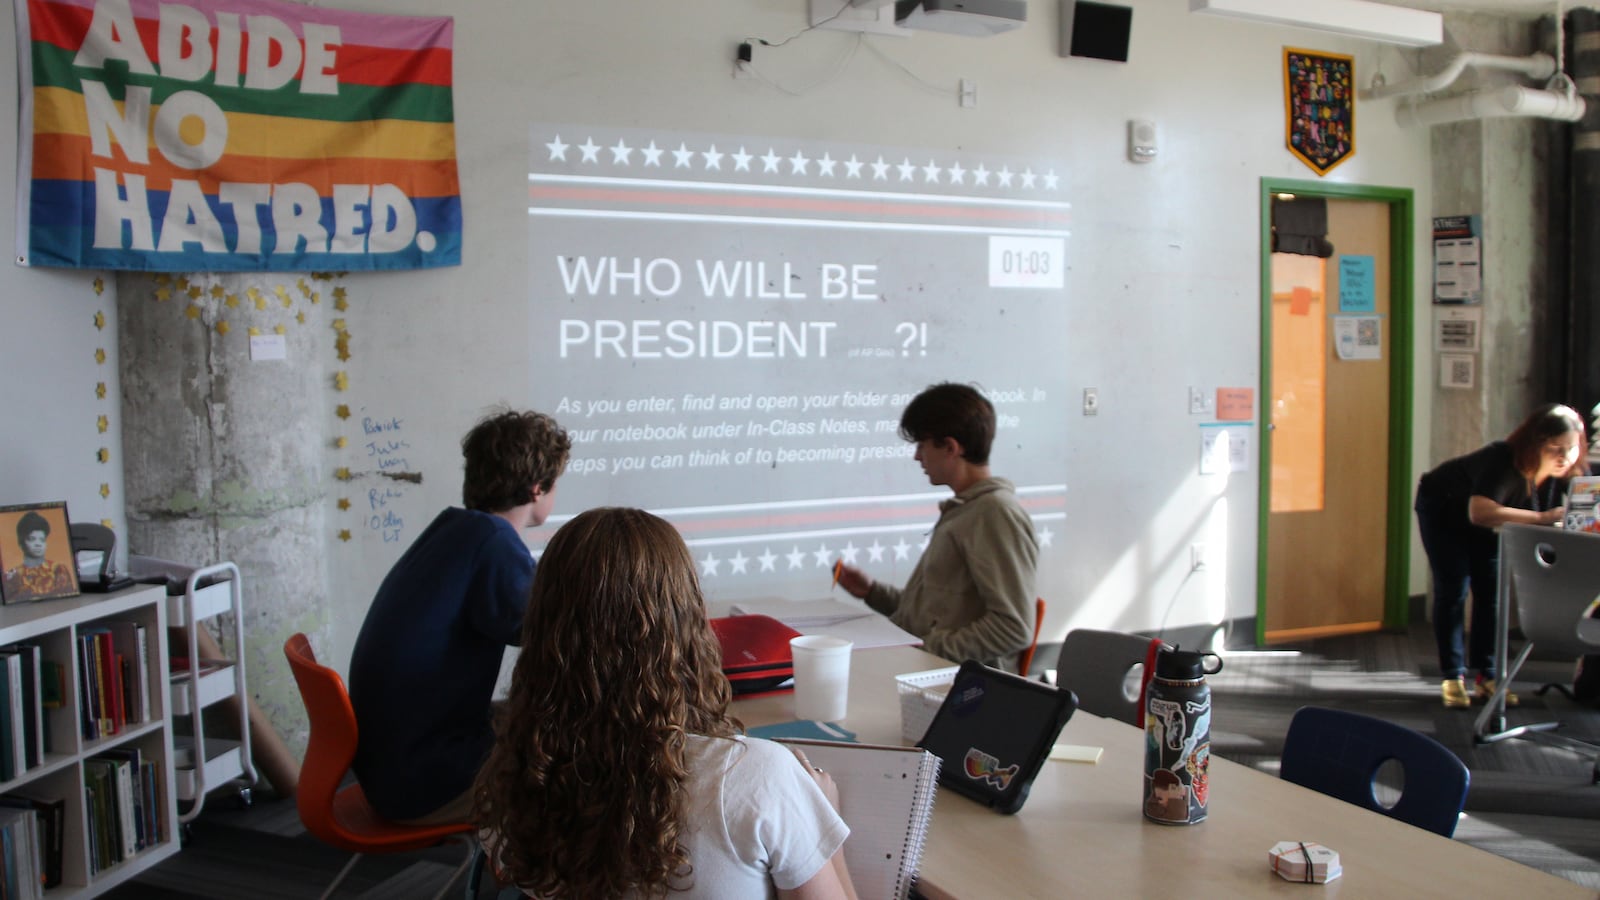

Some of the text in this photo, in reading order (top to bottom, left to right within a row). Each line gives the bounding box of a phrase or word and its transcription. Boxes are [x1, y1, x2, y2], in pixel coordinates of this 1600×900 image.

[73, 0, 343, 95] ABIDE
[80, 79, 228, 170] NO
[94, 167, 436, 254] HATRED.
[556, 255, 878, 301] WHO WILL BE
[1002, 249, 1050, 275] 01:03
[559, 319, 837, 358] PRESIDENT
[895, 321, 928, 358] ?!
[556, 396, 582, 414] As
[586, 399, 620, 418] you
[626, 396, 675, 413] enter,
[682, 393, 715, 411] find
[719, 393, 753, 410] and
[756, 395, 798, 413] open
[801, 394, 839, 413] your
[841, 391, 889, 408] folder
[1031, 387, 1047, 402] In
[568, 429, 600, 443] our
[602, 422, 687, 442] notebook
[692, 421, 744, 440] under
[746, 418, 816, 437] In-Class
[875, 420, 900, 433] ma
[566, 443, 916, 477] teps you can think of to becoming preside
